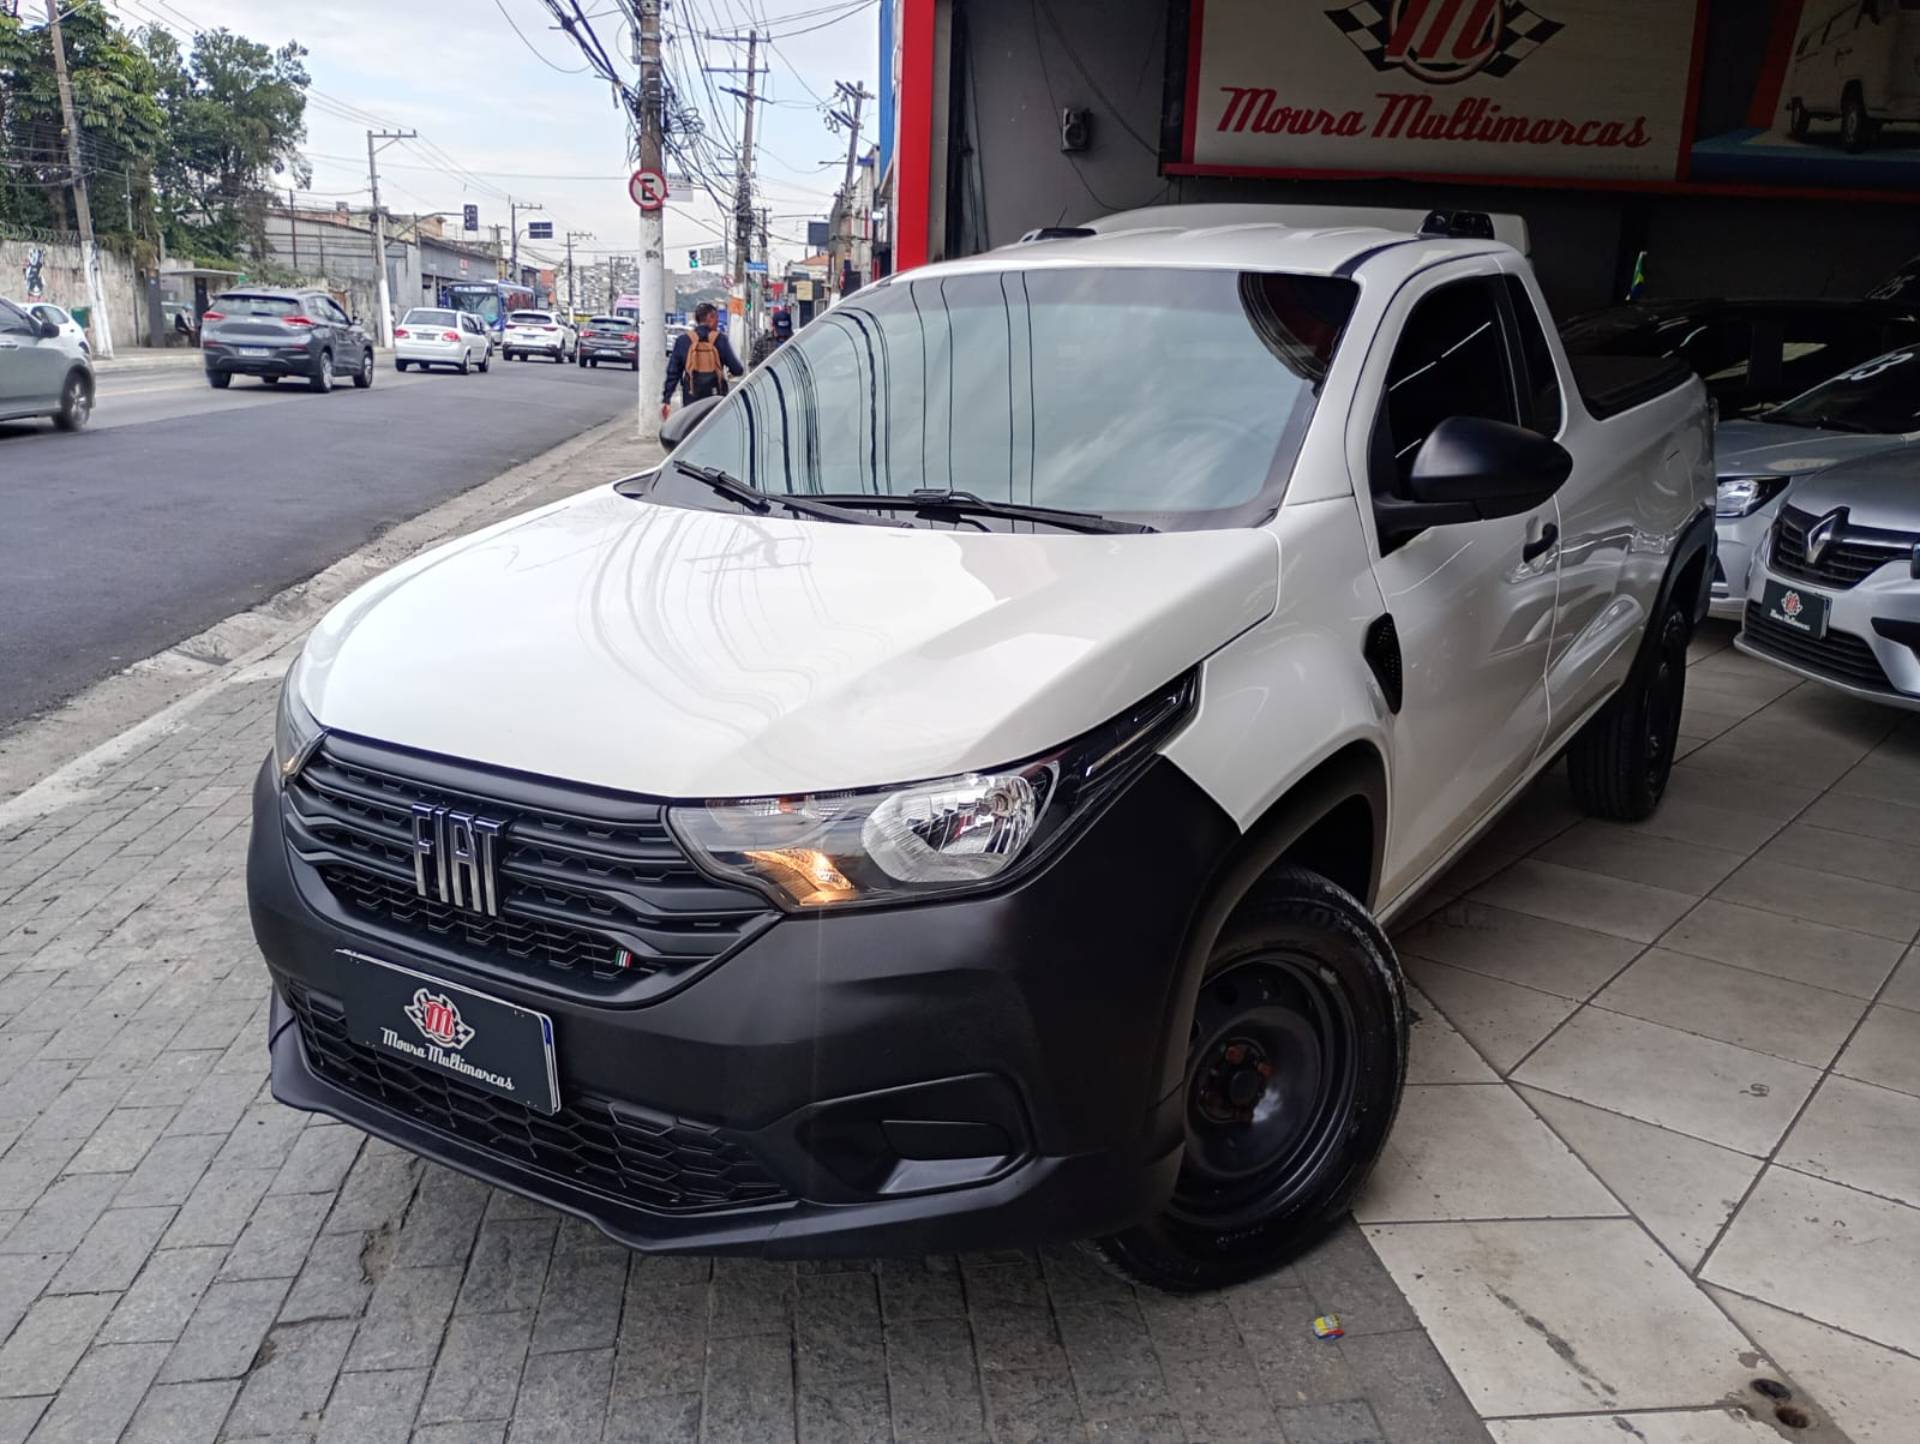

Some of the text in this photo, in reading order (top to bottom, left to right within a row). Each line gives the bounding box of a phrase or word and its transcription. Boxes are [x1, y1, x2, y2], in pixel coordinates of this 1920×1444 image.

[1217, 87, 1651, 148] Moura Multimarcas
[641, 178, 656, 200] E
[411, 802, 502, 916] FIAT
[380, 1026, 516, 1091] Moura Multimarcas
